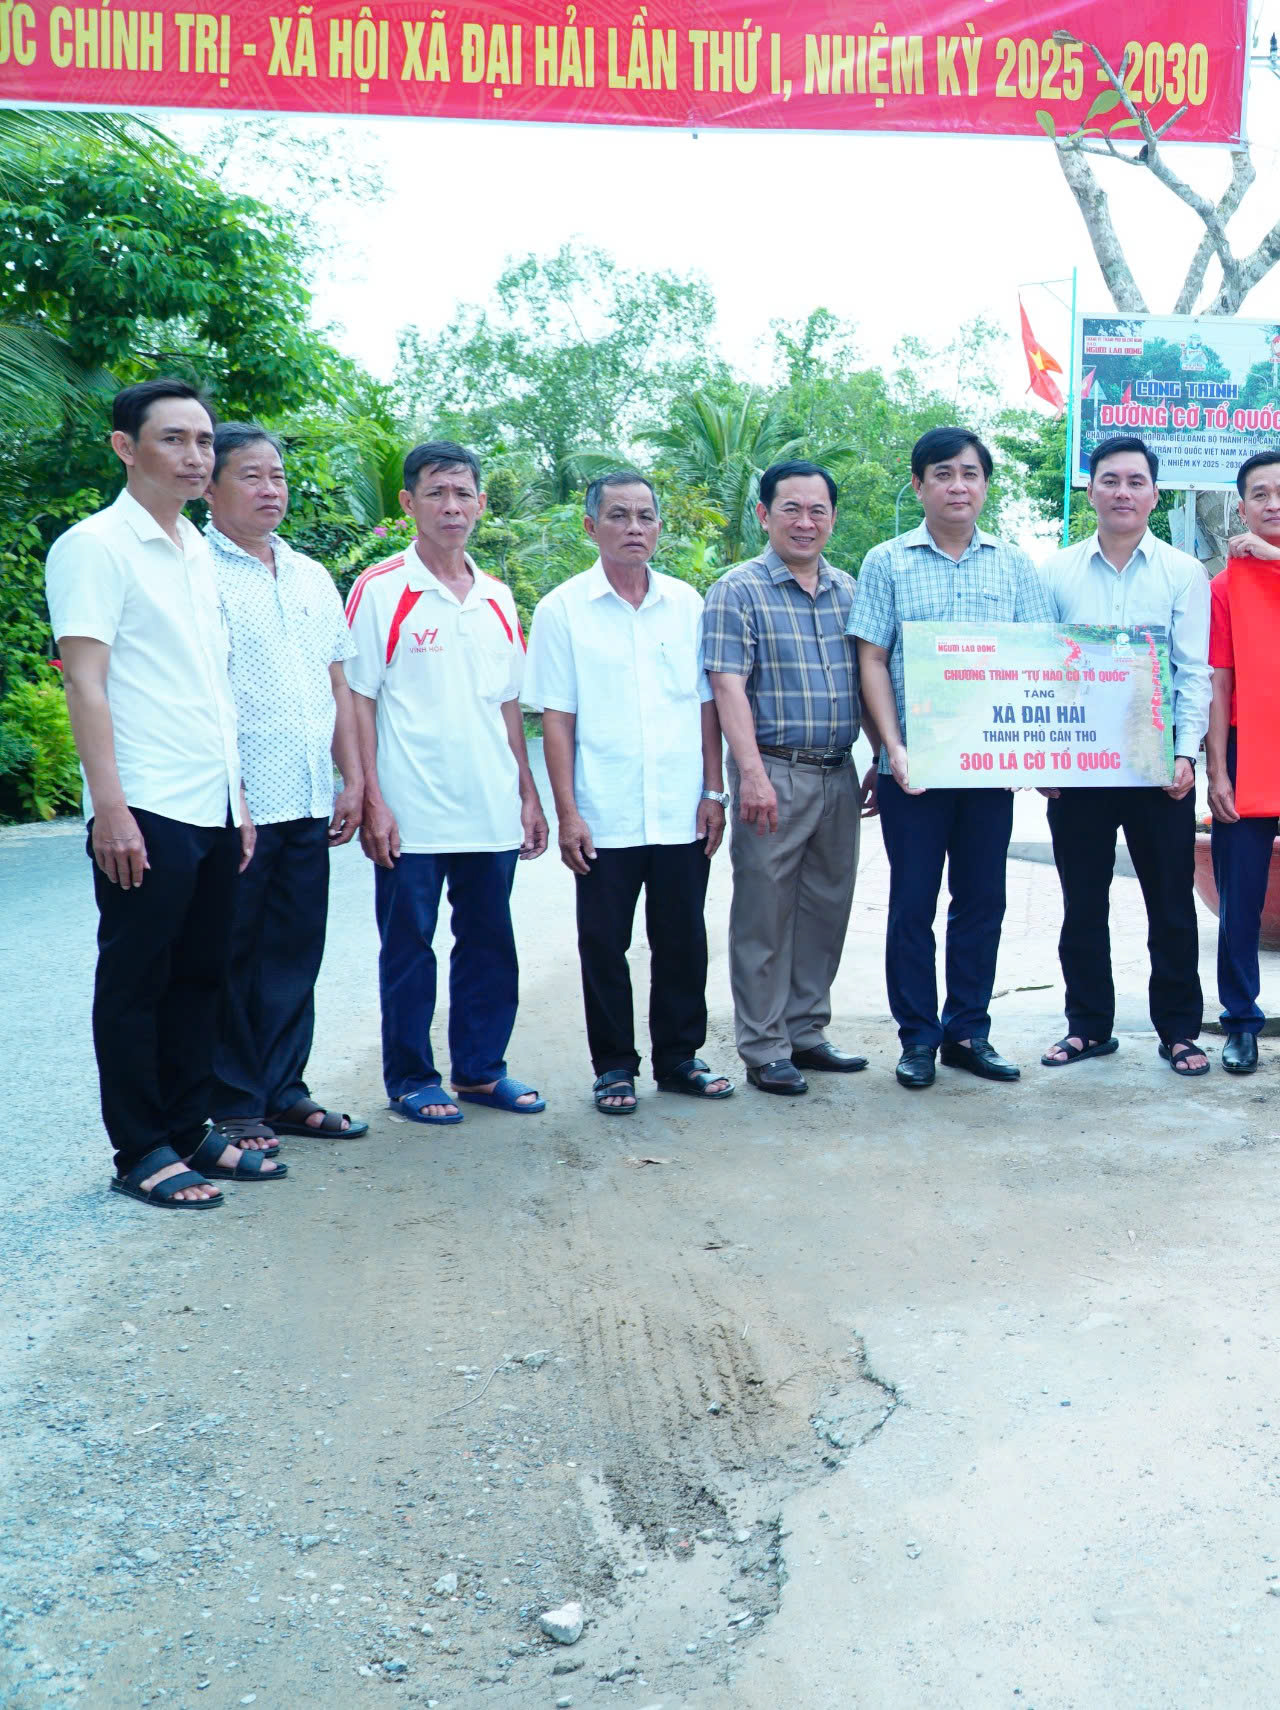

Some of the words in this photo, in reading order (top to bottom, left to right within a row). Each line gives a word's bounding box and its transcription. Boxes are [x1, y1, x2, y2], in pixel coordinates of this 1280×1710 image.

[50, 0, 163, 72] CHÍNH
[175, 13, 230, 88] TRỊ
[243, 43, 256, 56] -
[268, 5, 317, 77] XÃ
[329, 6, 389, 93] HỘI
[401, 9, 451, 82] XÃ
[461, 23, 522, 98] ĐẠI
[535, 4, 595, 88] HẢI
[608, 6, 677, 90] LẦN
[688, 18, 762, 93] THỨ
[771, 33, 792, 101] I,
[804, 22, 924, 108] NHIỆM
[937, 22, 983, 97] KỲ
[995, 37, 1084, 101] 2025
[1122, 40, 1208, 106] 2030
[1101, 401, 1167, 427] ĐƯỜNG
[1173, 402, 1199, 428] CỜ
[1204, 401, 1229, 429] TỔ
[1202, 460, 1219, 468] 2025
[1021, 705, 1051, 727] ĐẠI
[1056, 701, 1086, 724] HẢI
[960, 752, 994, 771] 300
[999, 749, 1018, 771] LÁ
[1023, 749, 1046, 771] CỜ
[1050, 746, 1072, 771] TỔ
[1077, 748, 1121, 772] QUỐC
